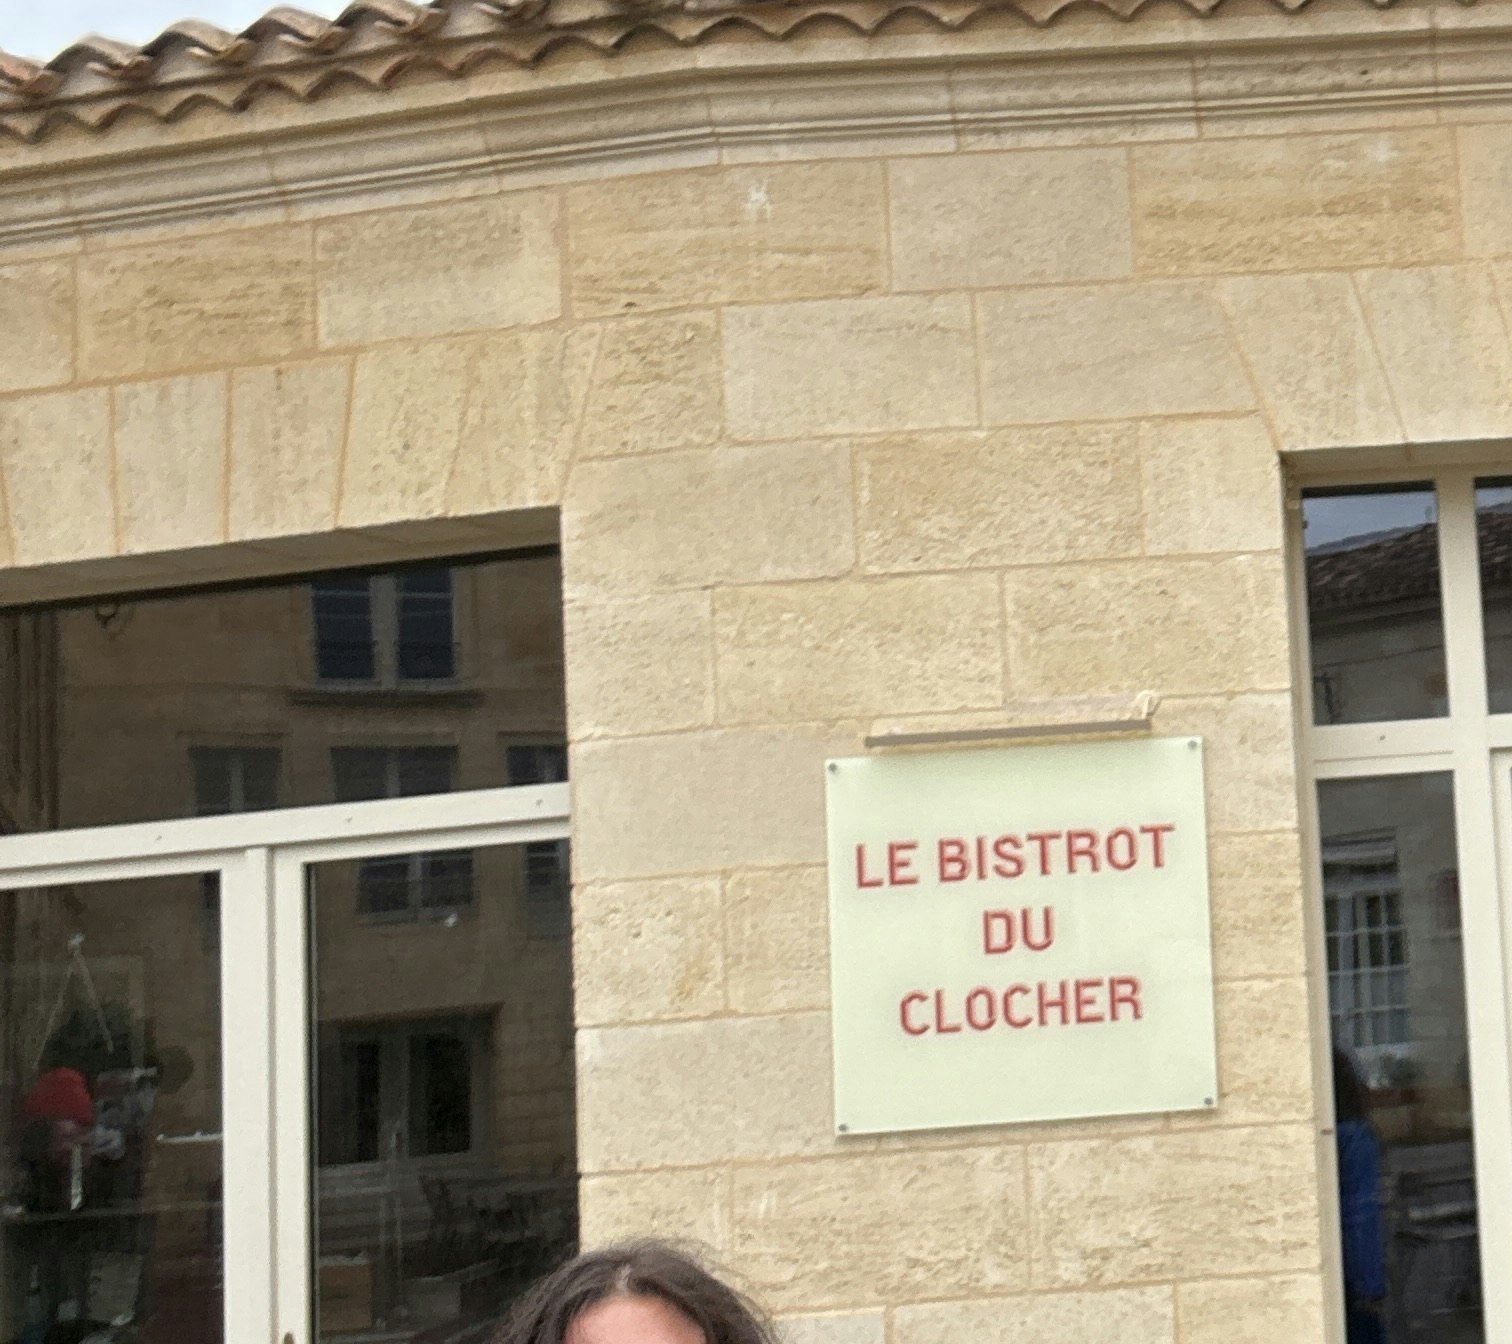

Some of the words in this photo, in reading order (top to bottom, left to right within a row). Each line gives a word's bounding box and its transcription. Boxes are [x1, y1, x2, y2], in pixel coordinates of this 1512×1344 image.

[855, 841, 919, 890] LE
[937, 823, 1175, 884] BISTROT
[981, 906, 1055, 957] DU
[898, 975, 1143, 1037] CLOCHER
